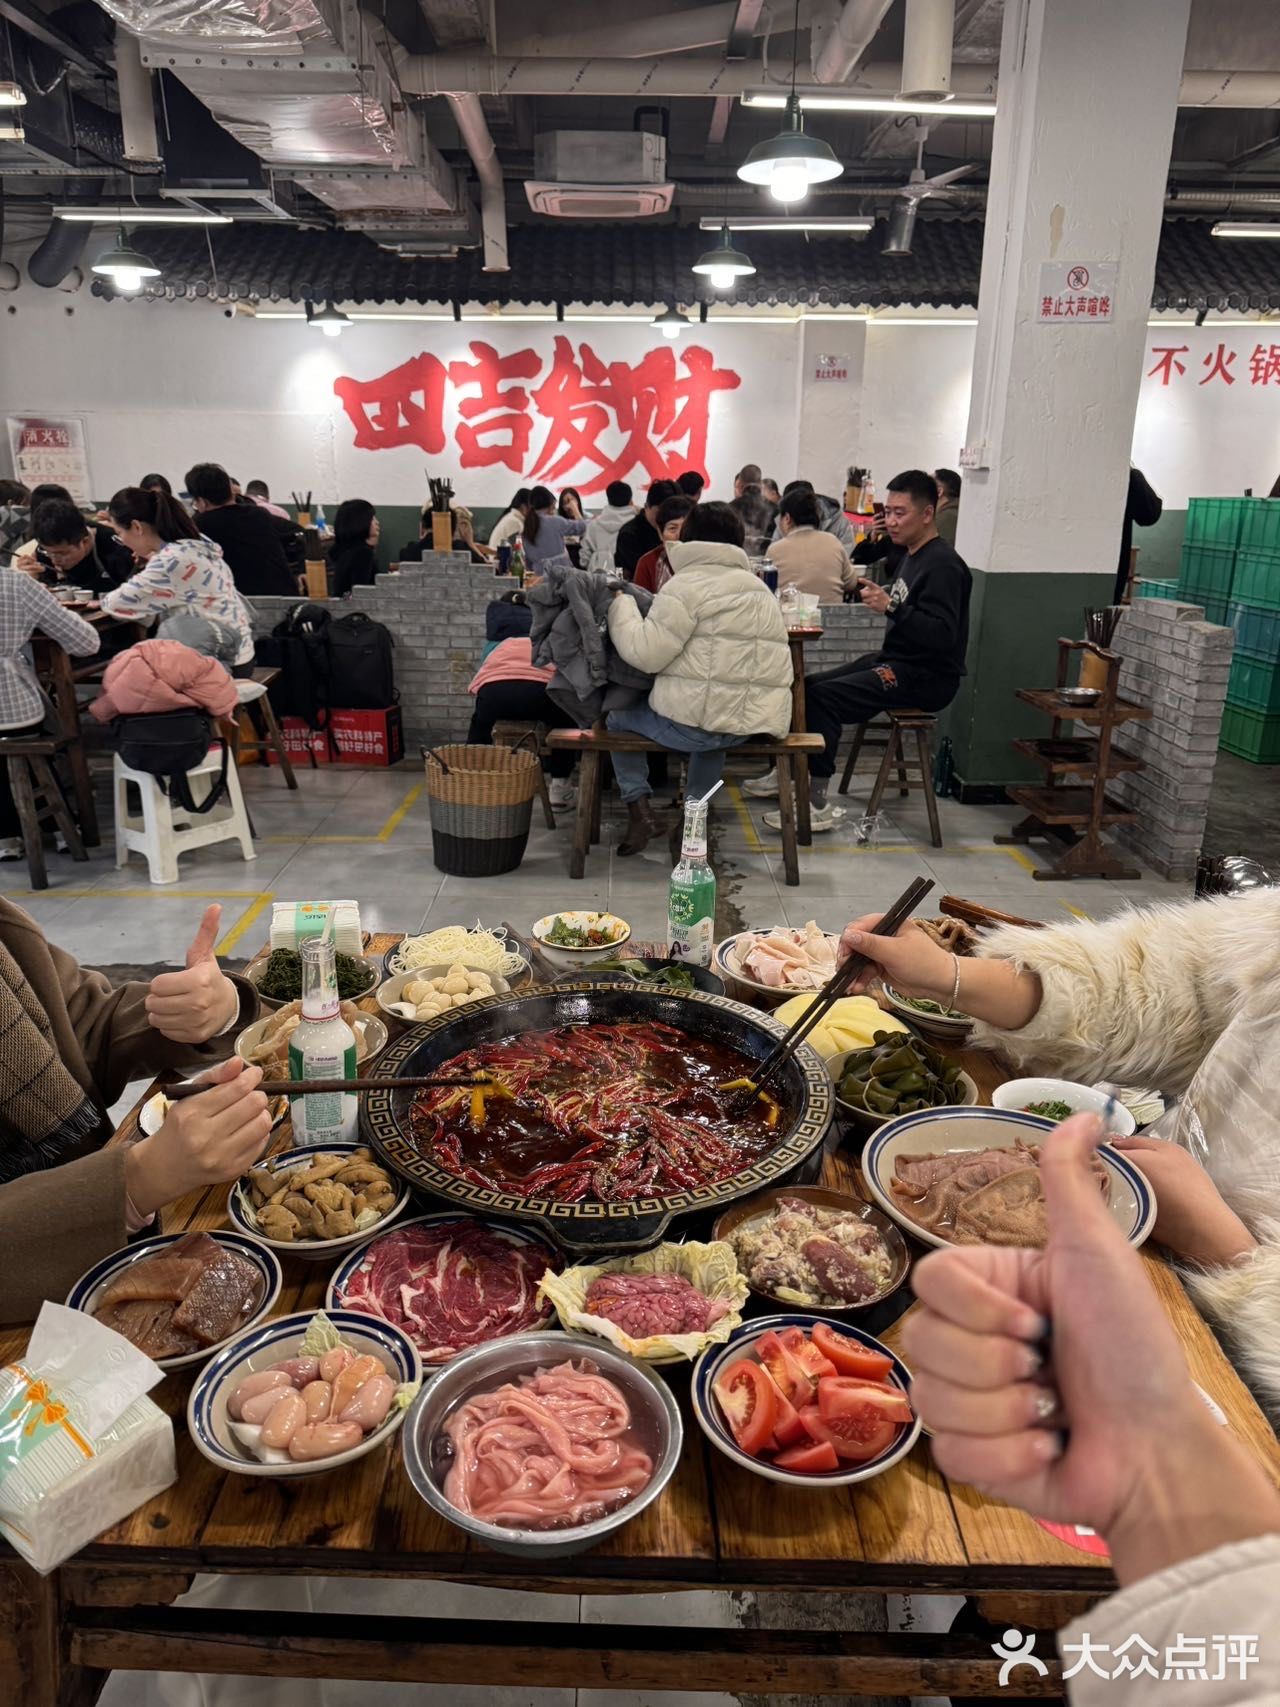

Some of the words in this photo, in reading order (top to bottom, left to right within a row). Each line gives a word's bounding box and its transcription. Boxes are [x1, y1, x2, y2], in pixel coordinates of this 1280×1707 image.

[1041, 295, 1110, 317] 禁止大声喧哗
[1147, 344, 1280, 385] 不火锅
[334, 335, 741, 495] 四吉发财
